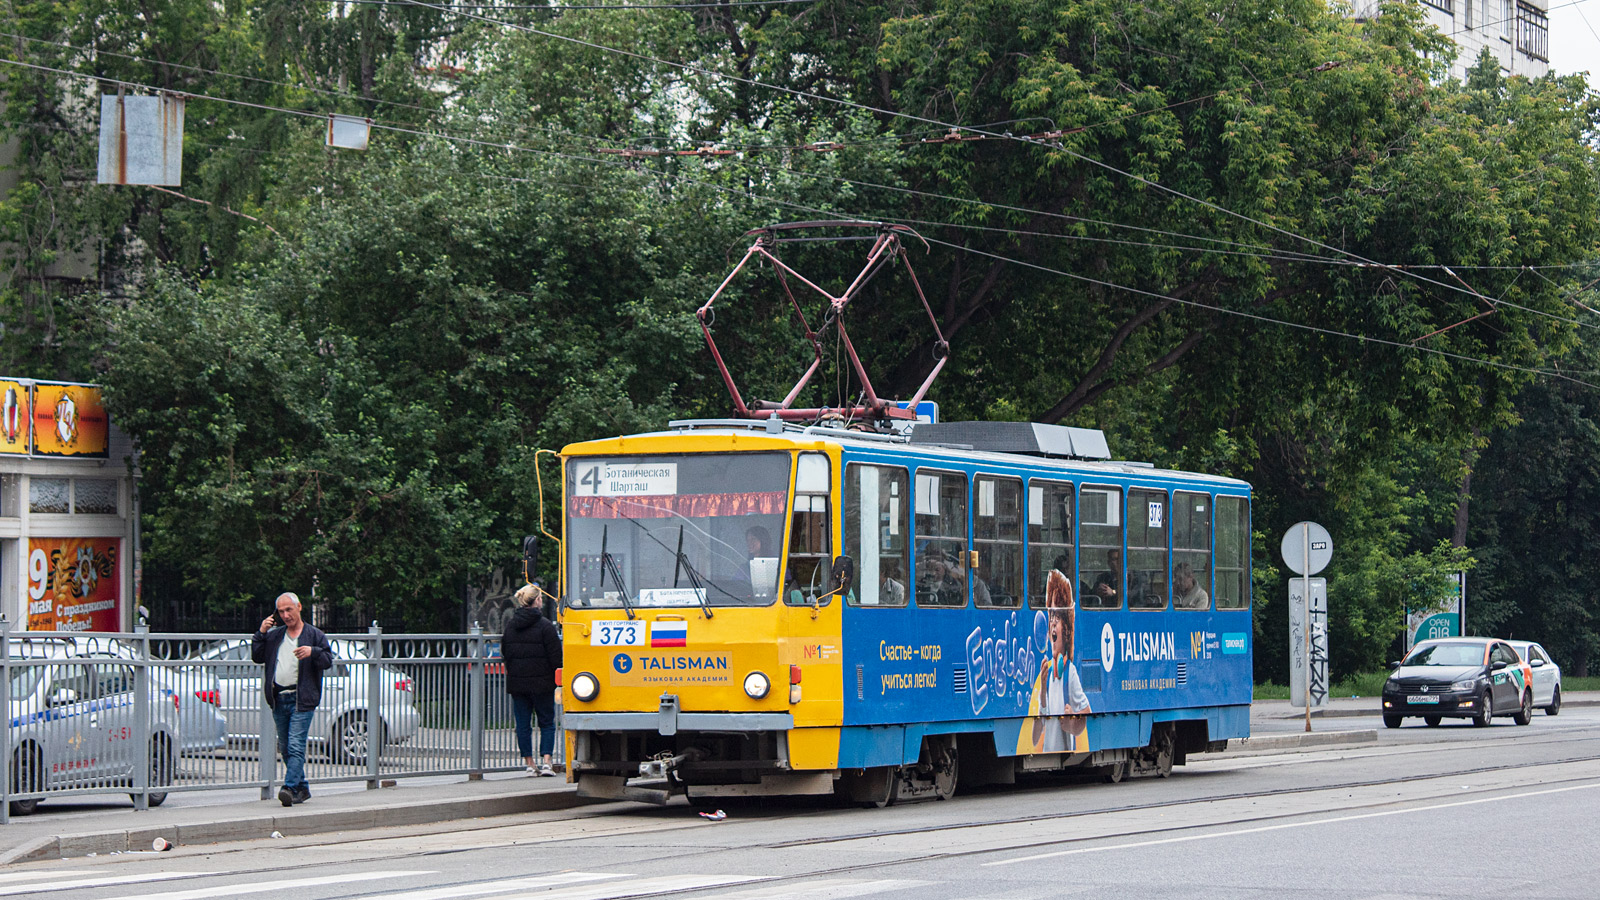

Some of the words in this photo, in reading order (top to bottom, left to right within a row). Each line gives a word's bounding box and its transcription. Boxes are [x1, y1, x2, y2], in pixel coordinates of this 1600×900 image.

[580, 466, 602, 494] 4
[604, 468, 670, 478] Ботаническая
[610, 481, 648, 493] Шарташ
[1150, 504, 1161, 522] 373
[29, 548, 48, 600] 9
[30, 600, 53, 615] мая
[56, 604, 63, 617] С
[64, 600, 115, 616] праздником
[56, 616, 92, 631] Победы!
[1429, 618, 1450, 627] OPEN
[600, 627, 636, 645] 373
[879, 640, 913, 661] Счастье
[920, 643, 942, 663] когда
[1118, 632, 1175, 661] TALISMAN
[639, 657, 727, 670] TALISMAN
[966, 620, 1036, 716] English
[881, 672, 914, 695] учиться
[913, 667, 937, 688] легко!
[1121, 679, 1149, 691] ЯЗЫКОВАЯ
[1149, 678, 1176, 691] АКАДЕМИЯ
